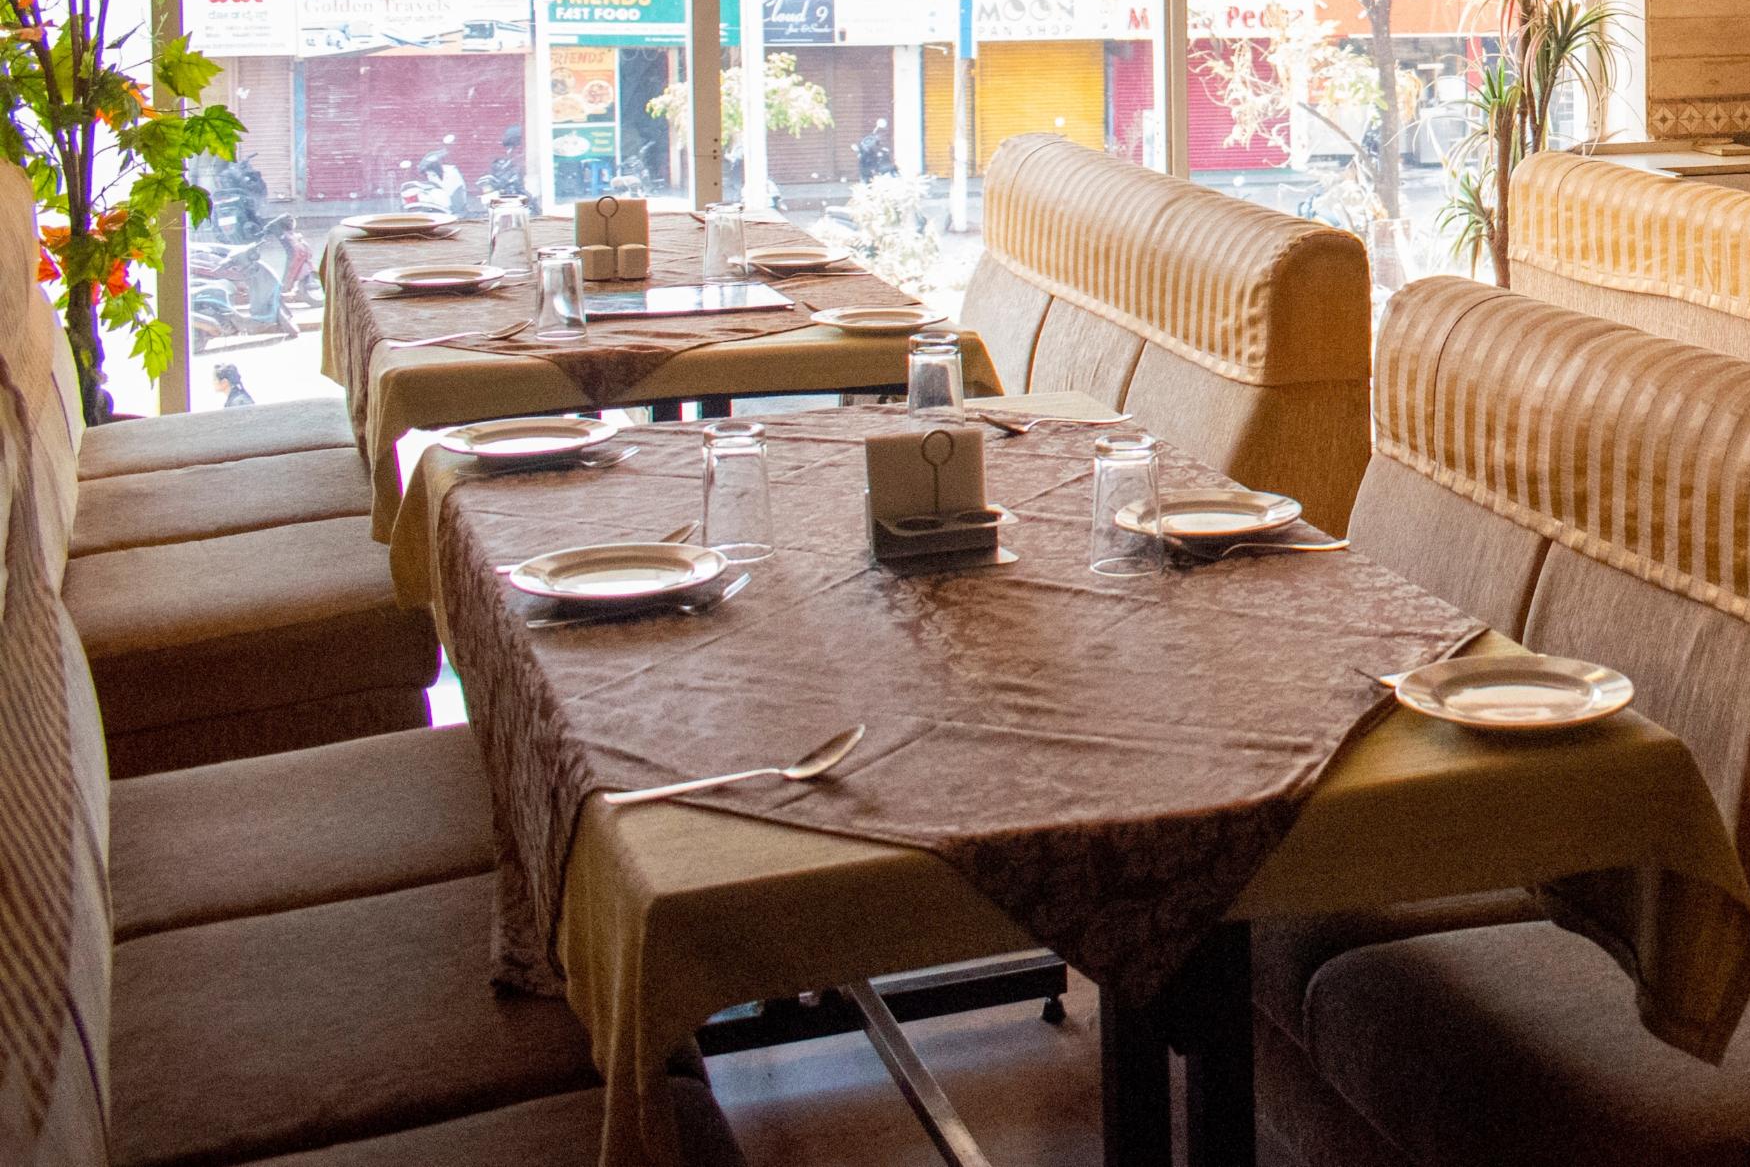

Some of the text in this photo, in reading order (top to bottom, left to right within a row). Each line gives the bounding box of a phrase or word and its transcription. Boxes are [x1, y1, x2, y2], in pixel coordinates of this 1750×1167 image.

[556, 7, 641, 21] FAST FOOD
[816, 6, 828, 23] 9
[978, 25, 1073, 36] PAN SHOP
